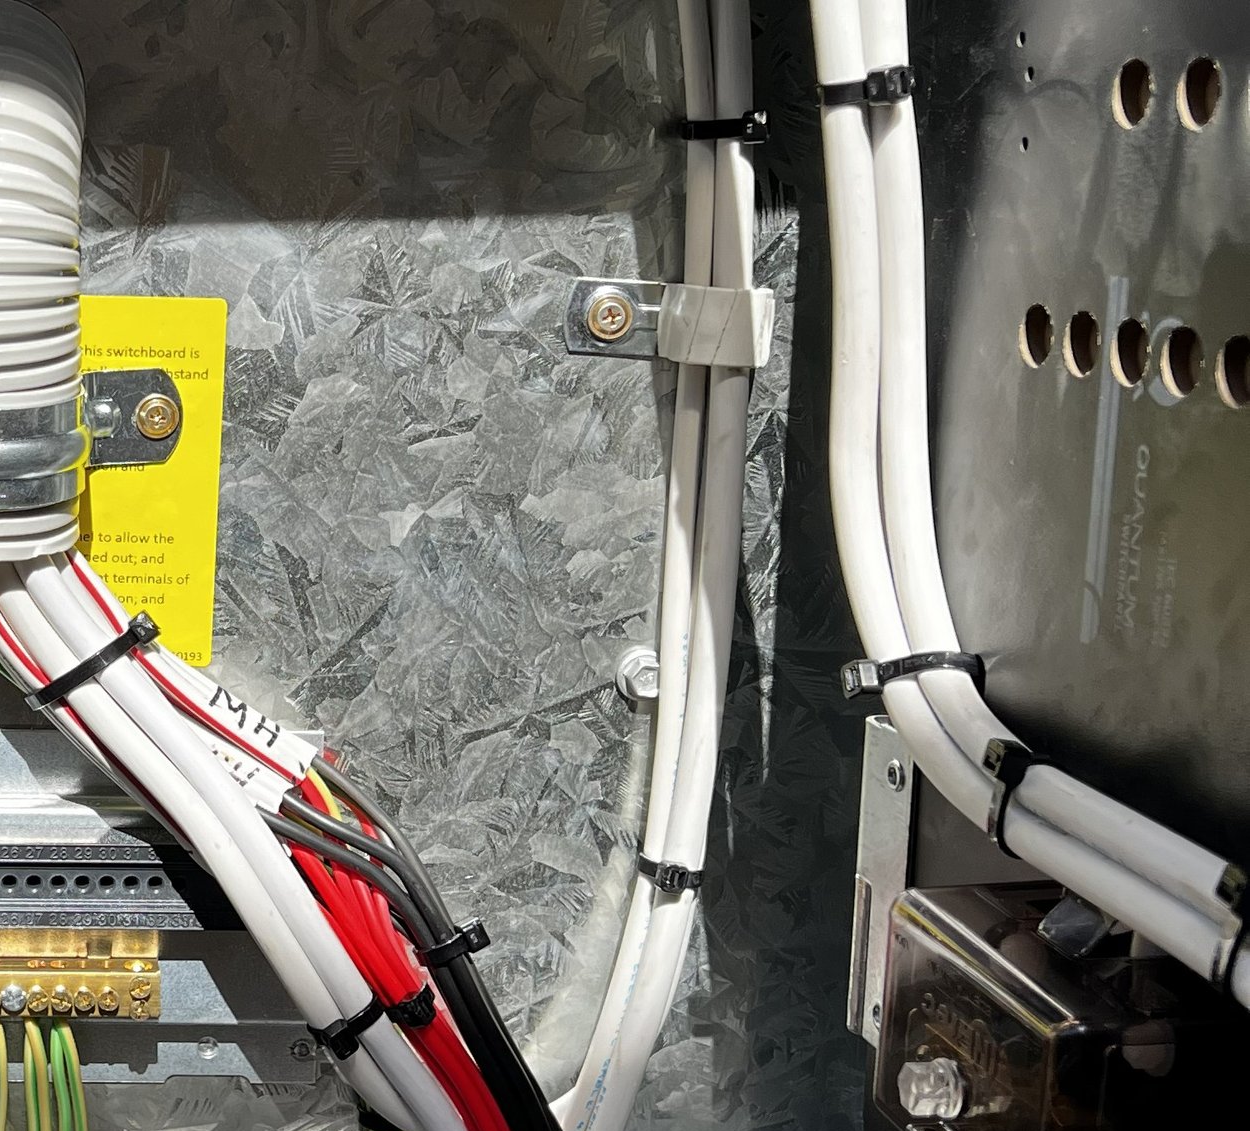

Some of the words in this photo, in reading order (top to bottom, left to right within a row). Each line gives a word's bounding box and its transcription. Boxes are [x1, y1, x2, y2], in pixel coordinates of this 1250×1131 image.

[106, 346, 186, 359] switchboard
[190, 348, 201, 359] is
[98, 533, 112, 543] to
[115, 532, 150, 543] allow
[153, 533, 175, 544] the
[112, 554, 137, 566] out;
[141, 553, 165, 565] and
[113, 574, 173, 585] terminals
[176, 574, 190, 585] of
[141, 594, 165, 605] and
[172, 651, 202, 662] 0193
[1, 846, 19, 859] 26
[25, 847, 44, 859] 27
[50, 847, 68, 859] 28
[74, 847, 93, 859] 29
[123, 848, 141, 860] 31
[25, 913, 44, 925] 27
[50, 913, 68, 925] 28
[74, 913, 93, 925] 29
